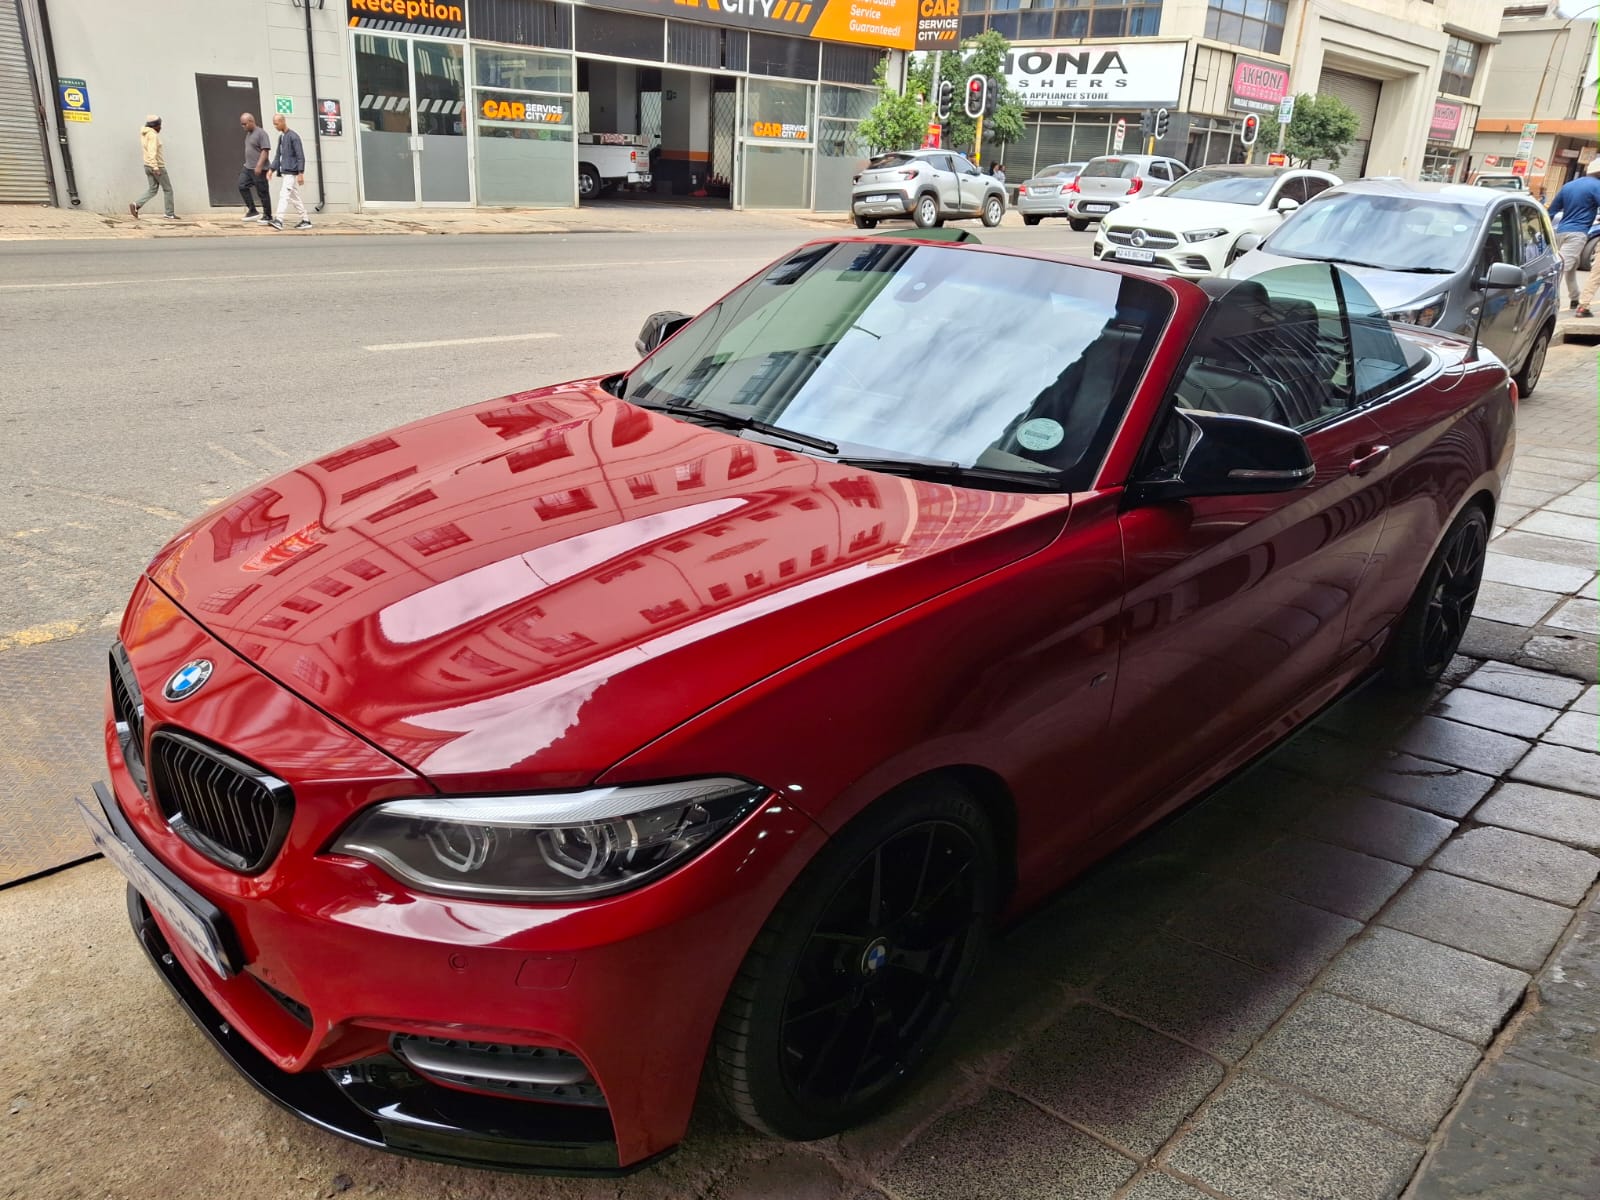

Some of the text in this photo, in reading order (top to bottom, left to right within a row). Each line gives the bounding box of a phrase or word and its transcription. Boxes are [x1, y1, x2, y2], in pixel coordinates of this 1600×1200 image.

[351, 0, 462, 21] Reception
[722, 0, 774, 18] CITY
[850, 4, 881, 19] Service
[920, 0, 959, 17] CAR
[849, 20, 901, 37] Guaranteed!
[918, 19, 959, 30] SERVICE
[918, 31, 940, 41] CITY
[993, 51, 1128, 74] HONA
[1018, 79, 1128, 88] SHERS
[1239, 66, 1284, 90] AKHONA
[1029, 92, 1078, 100] APPLIANCE
[1080, 92, 1110, 100] STORE
[483, 99, 564, 119] CAR SERVICE
[525, 112, 547, 121] CITY
[753, 121, 808, 138] CAR SERVICE
[782, 130, 796, 138] CITY
